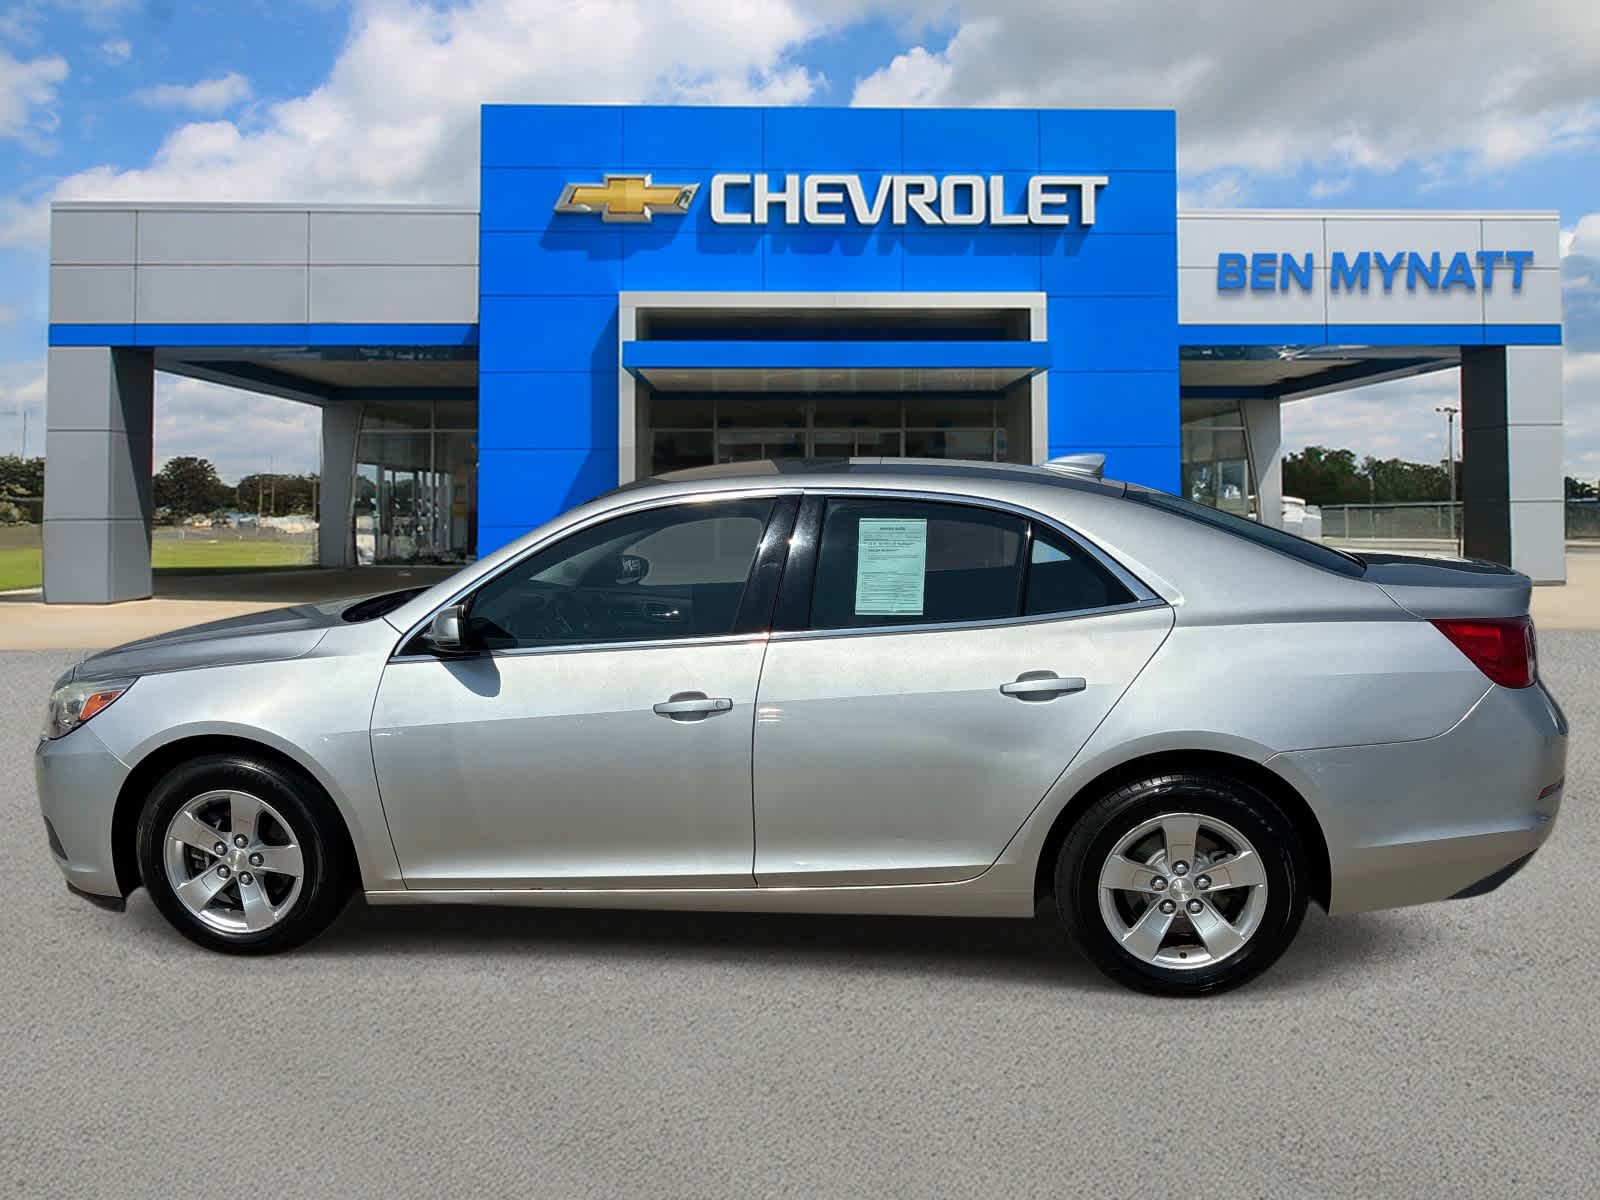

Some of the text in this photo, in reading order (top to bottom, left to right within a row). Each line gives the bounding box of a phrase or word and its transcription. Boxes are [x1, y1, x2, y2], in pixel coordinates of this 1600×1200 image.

[710, 173, 1109, 226] CHEVROLET
[1217, 251, 1534, 291] BEN MYNATT
